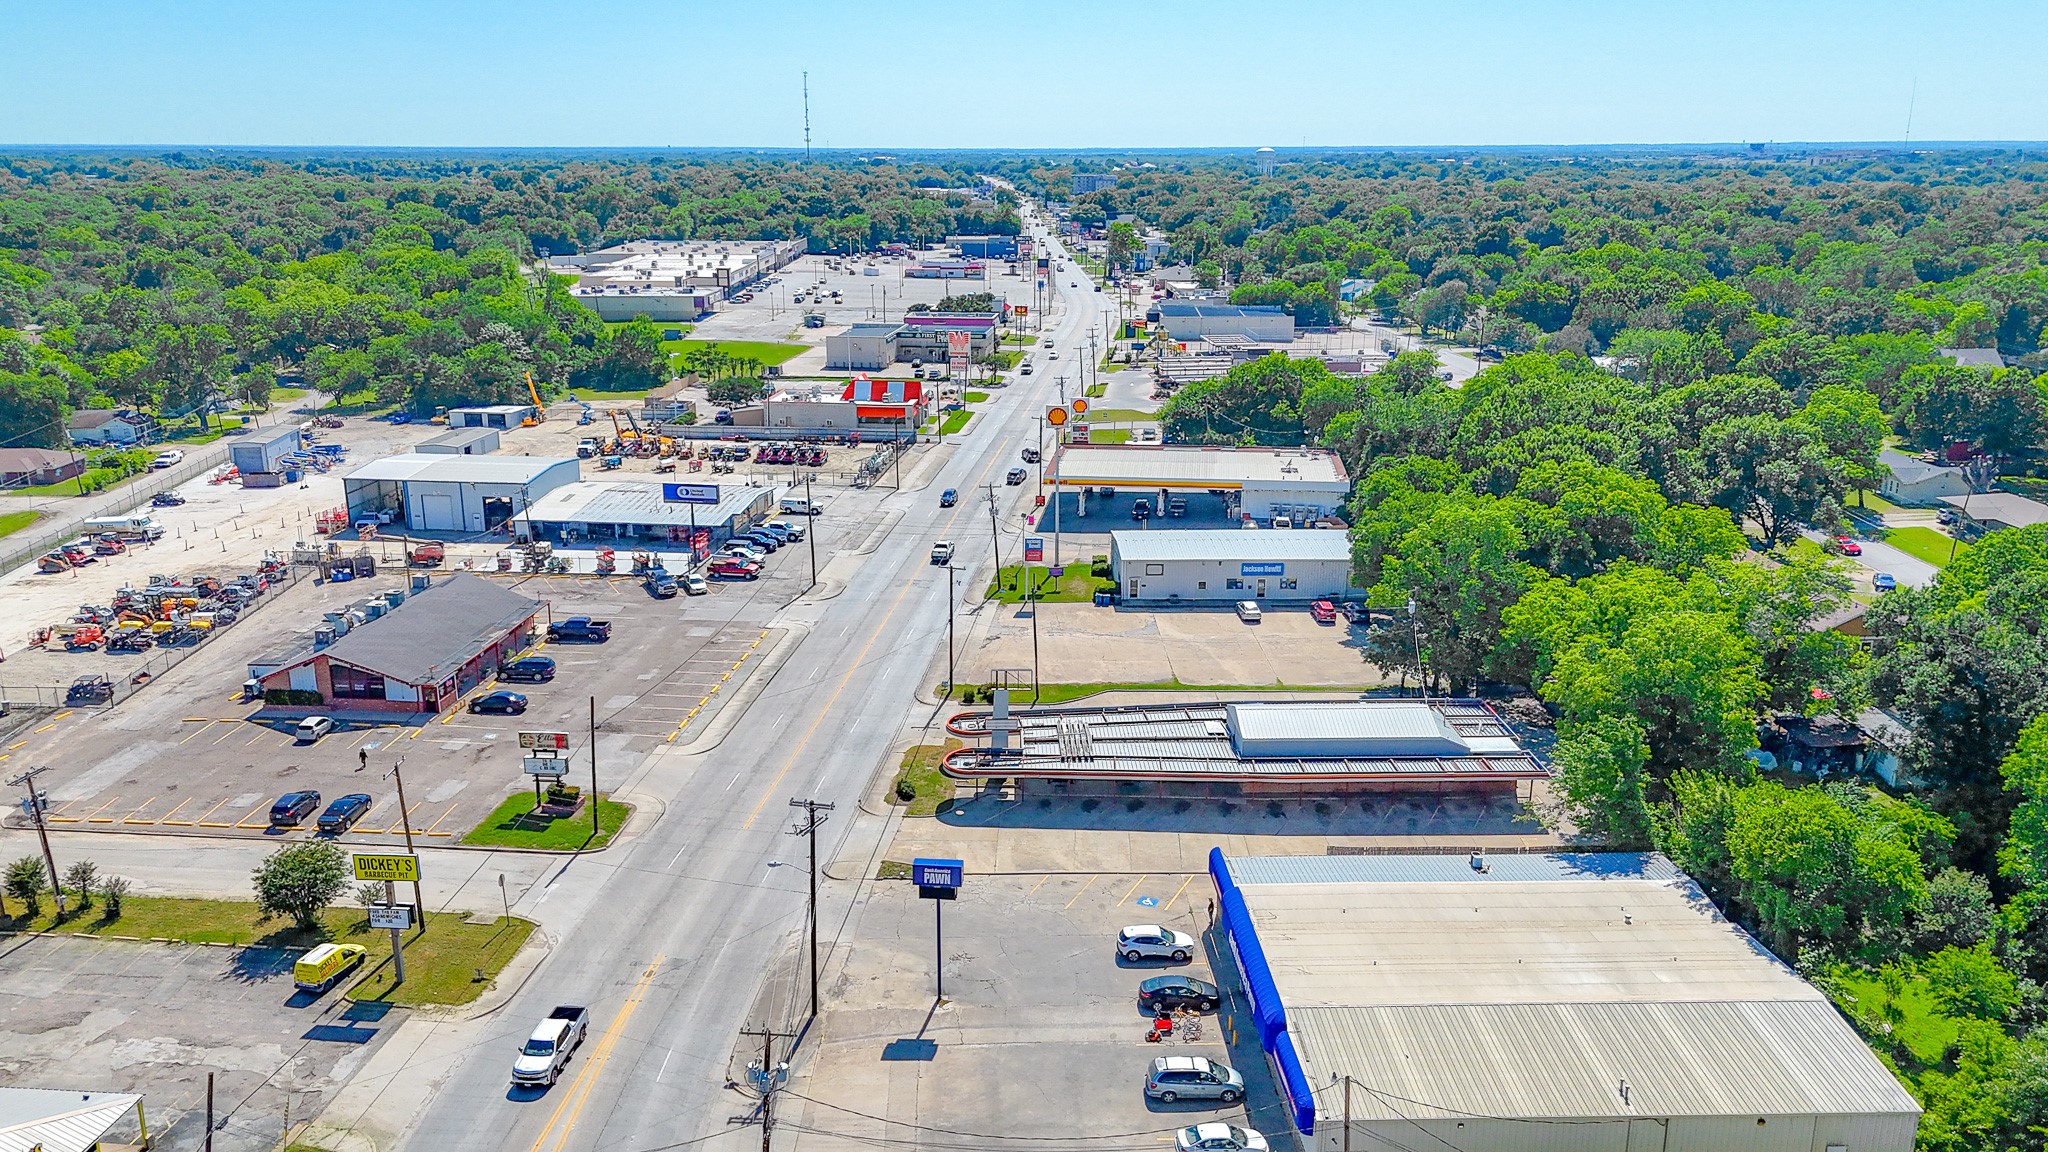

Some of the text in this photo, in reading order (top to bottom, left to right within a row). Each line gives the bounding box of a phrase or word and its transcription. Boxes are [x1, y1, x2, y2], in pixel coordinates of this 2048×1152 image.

[358, 857, 413, 872] DICKEY'S
[364, 871, 397, 879] BARBECUE
[924, 873, 951, 885] PAWN
